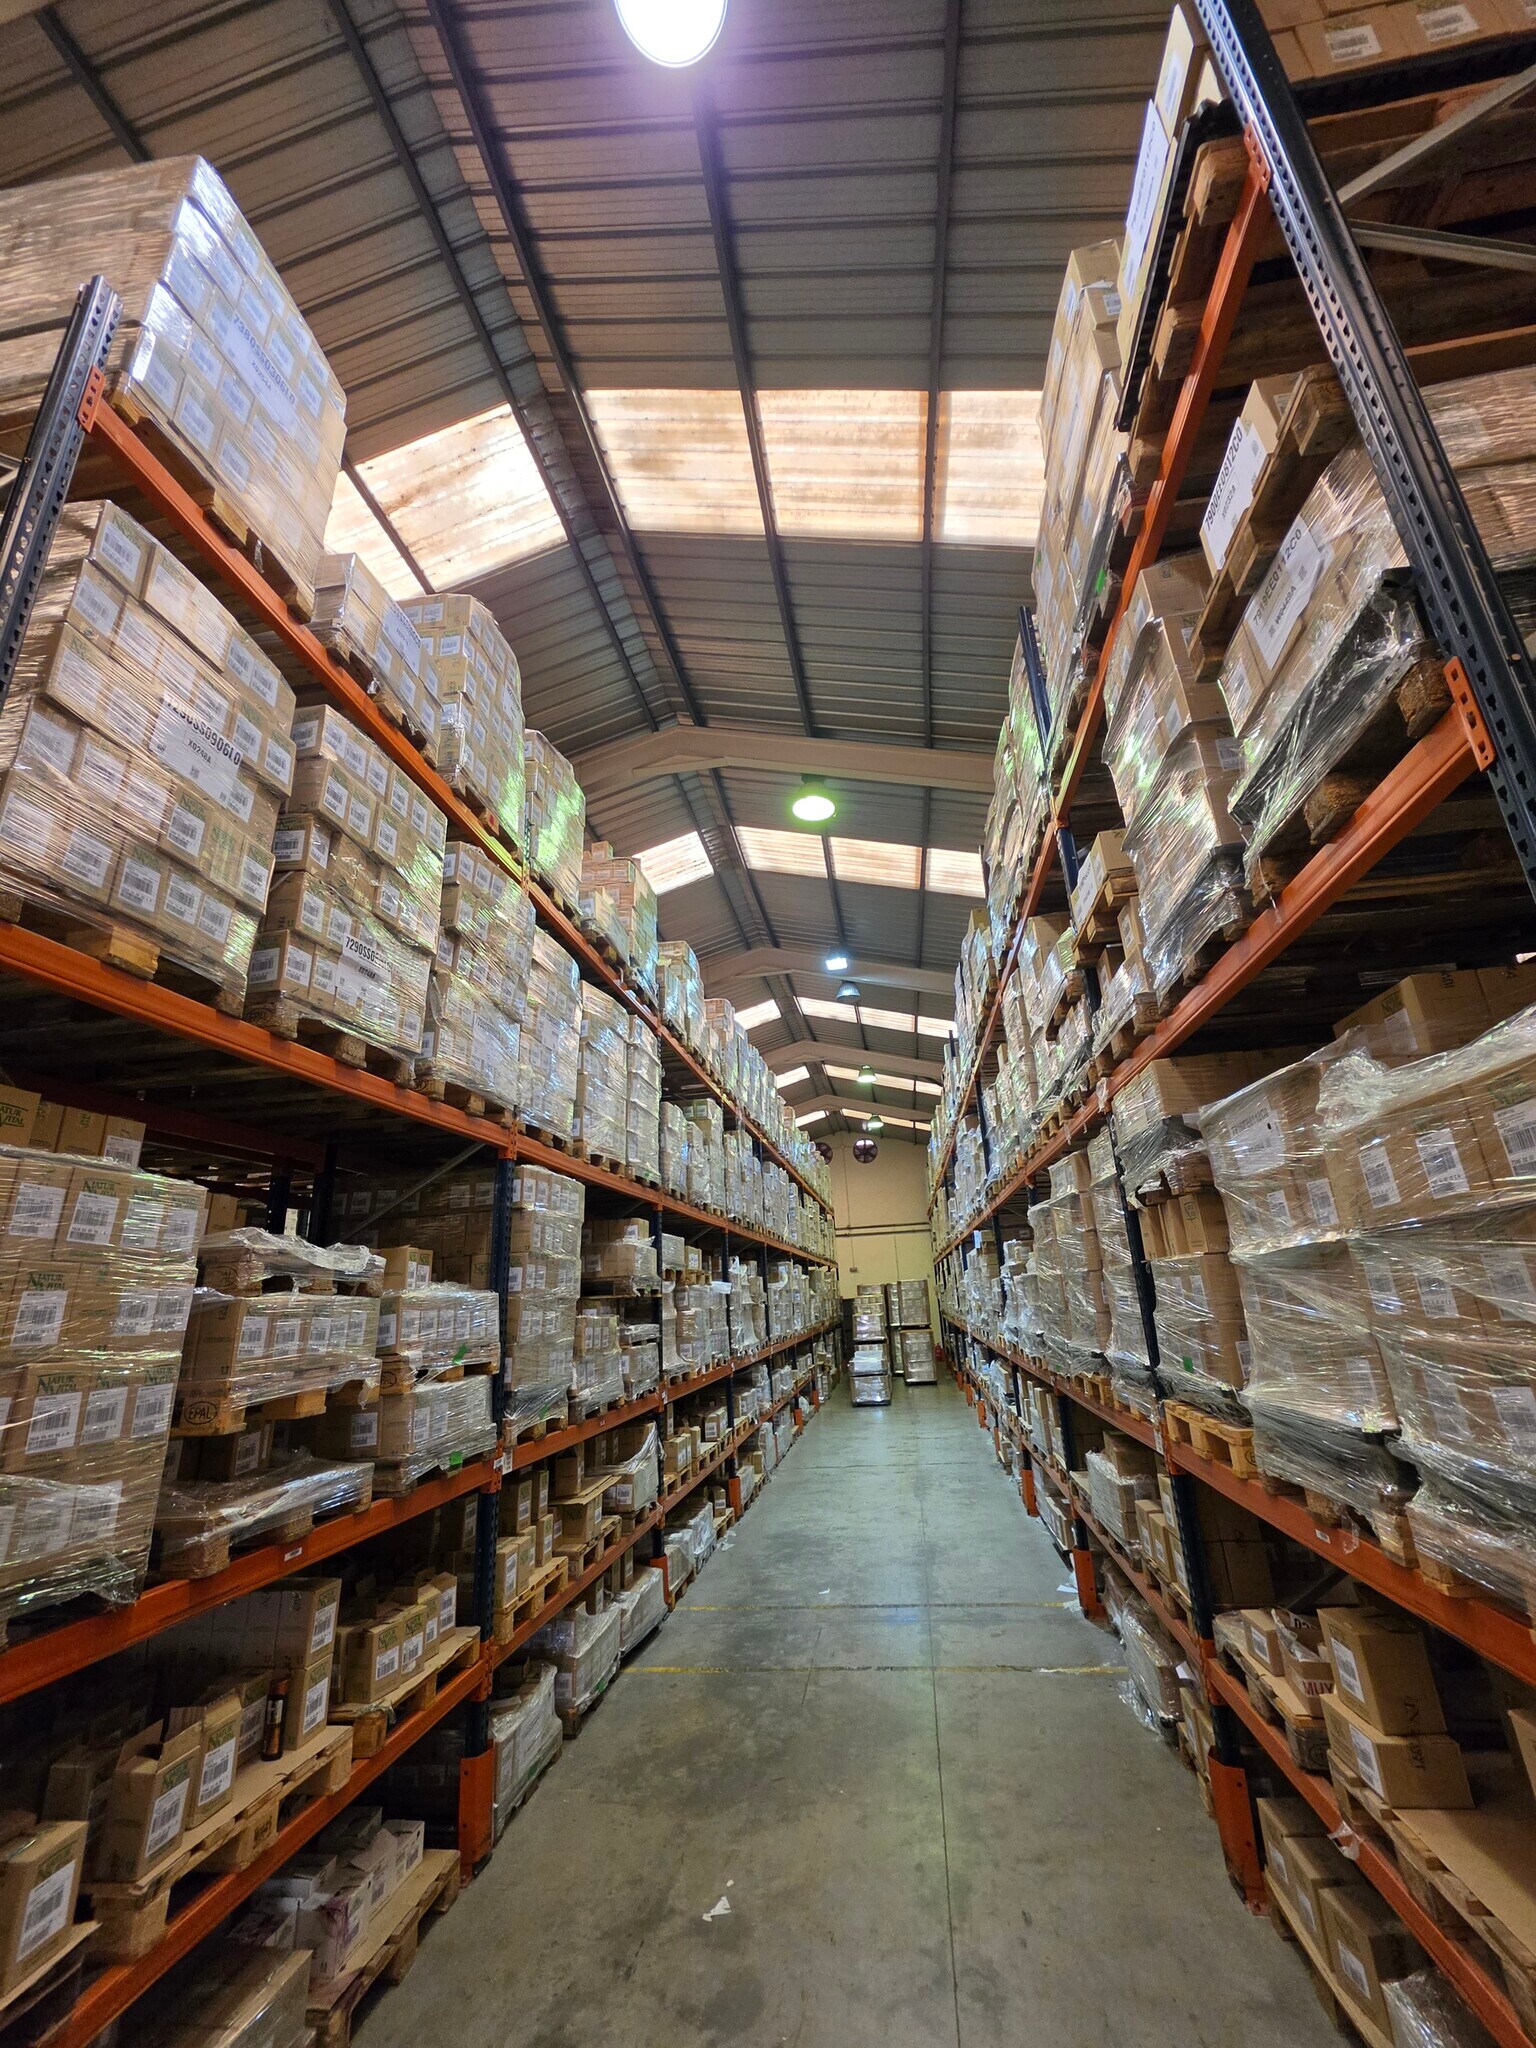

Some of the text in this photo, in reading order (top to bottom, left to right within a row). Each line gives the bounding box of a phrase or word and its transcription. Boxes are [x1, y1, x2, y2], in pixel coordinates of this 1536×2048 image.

[166, 701, 242, 766] 290SS0906L0
[0, 1105, 22, 1117] ATUR
[188, 1407, 213, 1420] EPAL
